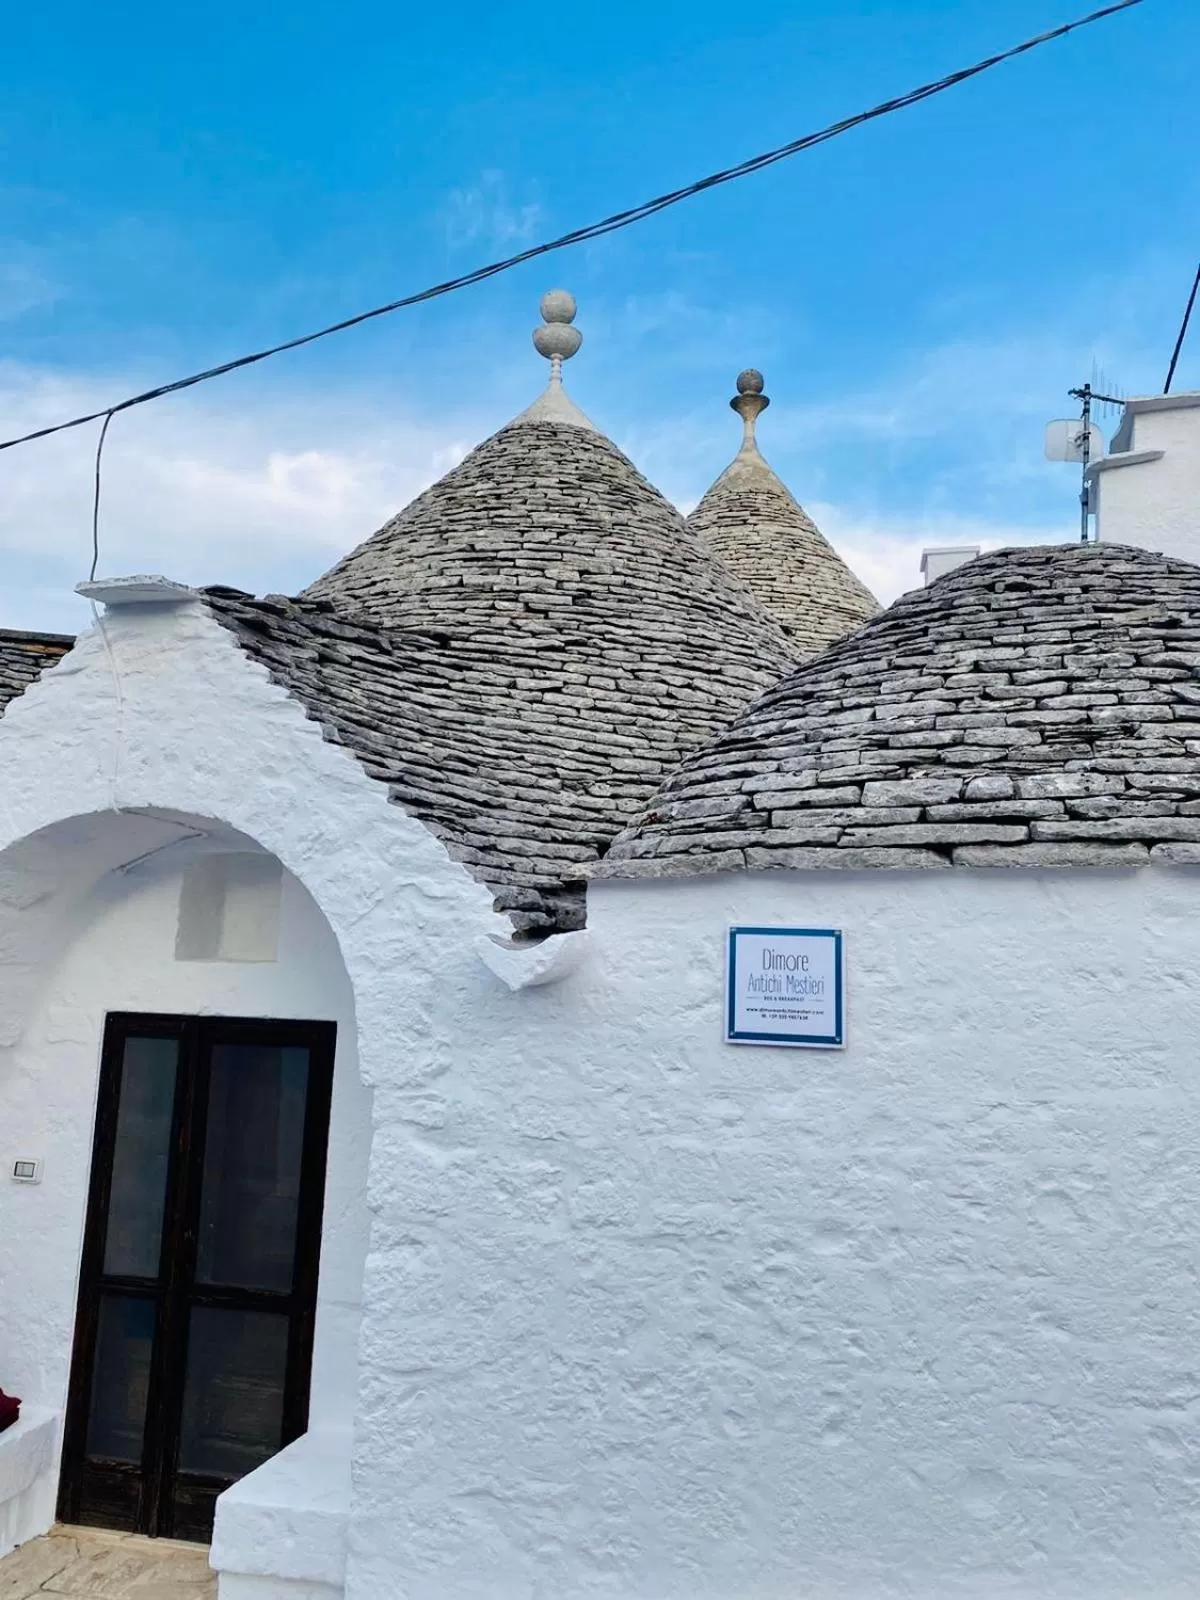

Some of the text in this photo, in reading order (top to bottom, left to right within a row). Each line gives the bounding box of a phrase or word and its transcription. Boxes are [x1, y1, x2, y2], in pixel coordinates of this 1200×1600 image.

[762, 948, 809, 972] Dimore
[747, 973, 825, 996] Antichi Mestieri
